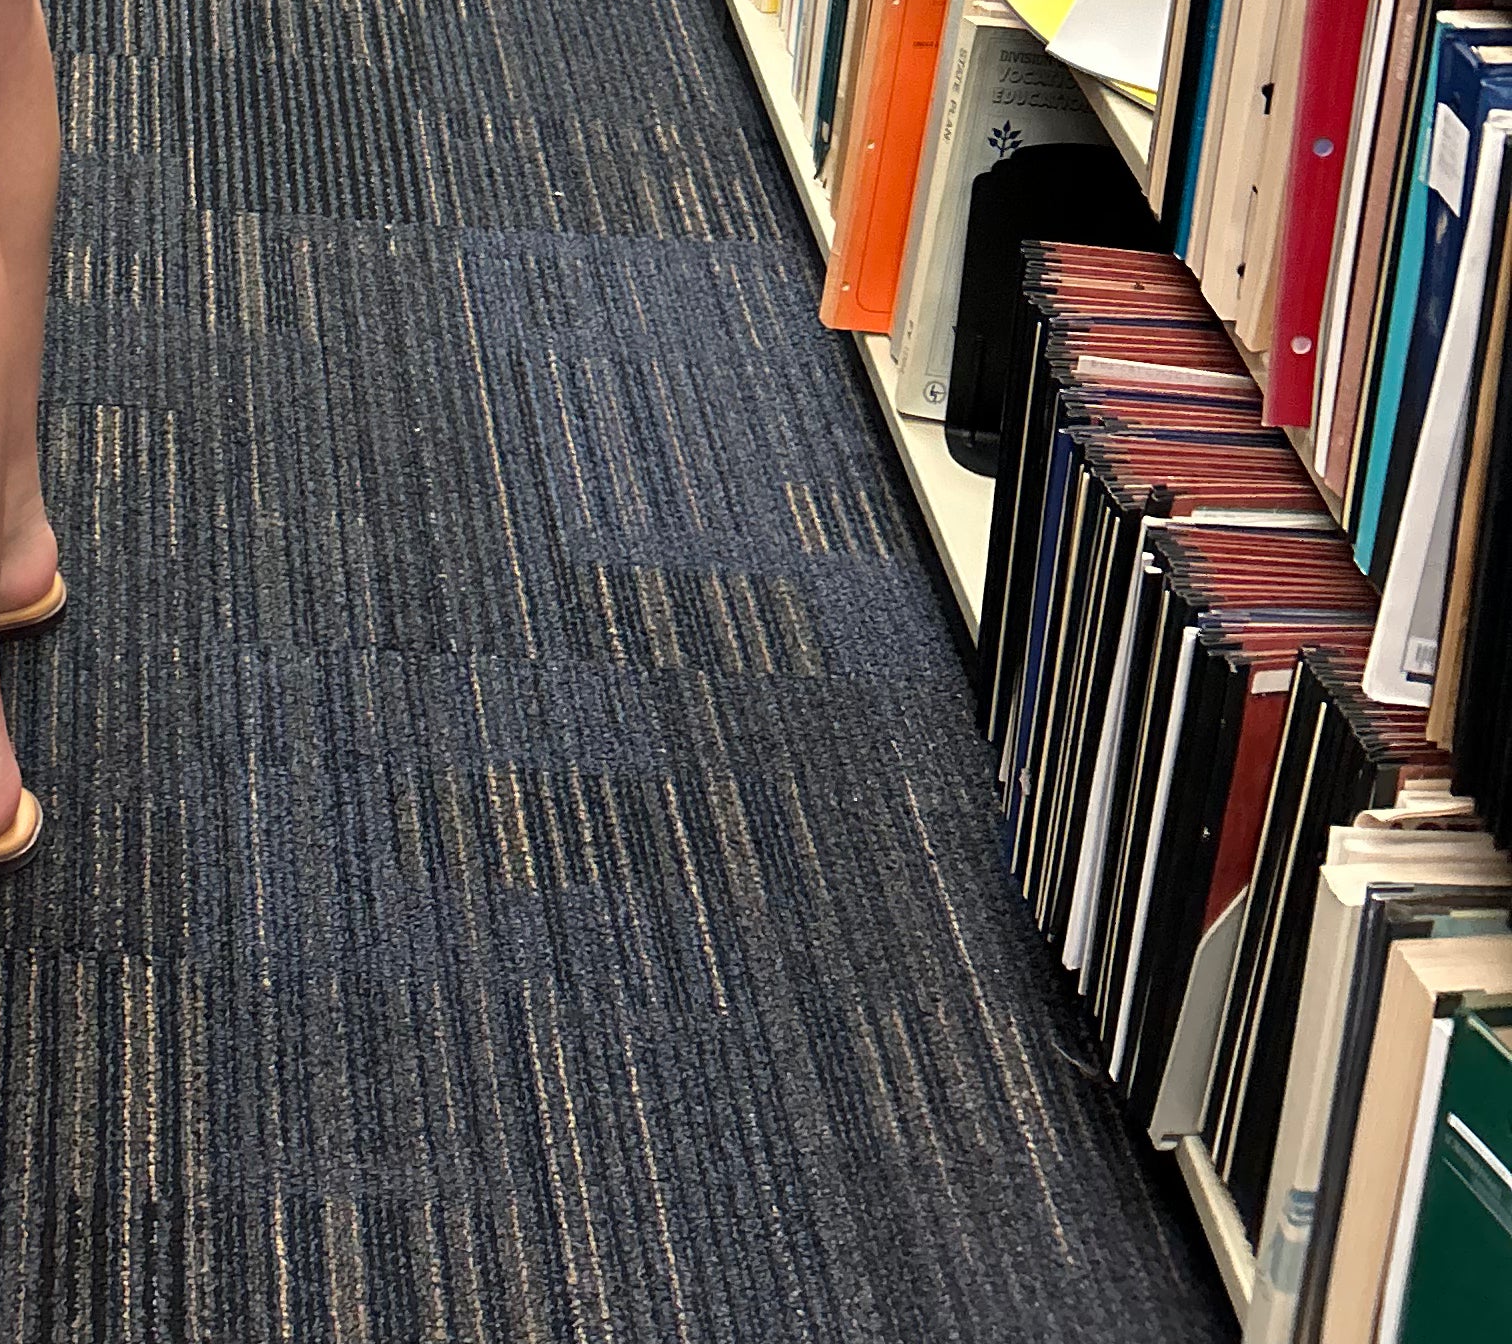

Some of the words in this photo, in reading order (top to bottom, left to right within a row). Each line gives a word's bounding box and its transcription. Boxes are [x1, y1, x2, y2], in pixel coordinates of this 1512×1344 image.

[951, 47, 968, 94] STATE
[999, 65, 1080, 89] VOCATIO
[992, 86, 1089, 113] EDUCATIO
[942, 98, 958, 141] PLAN
